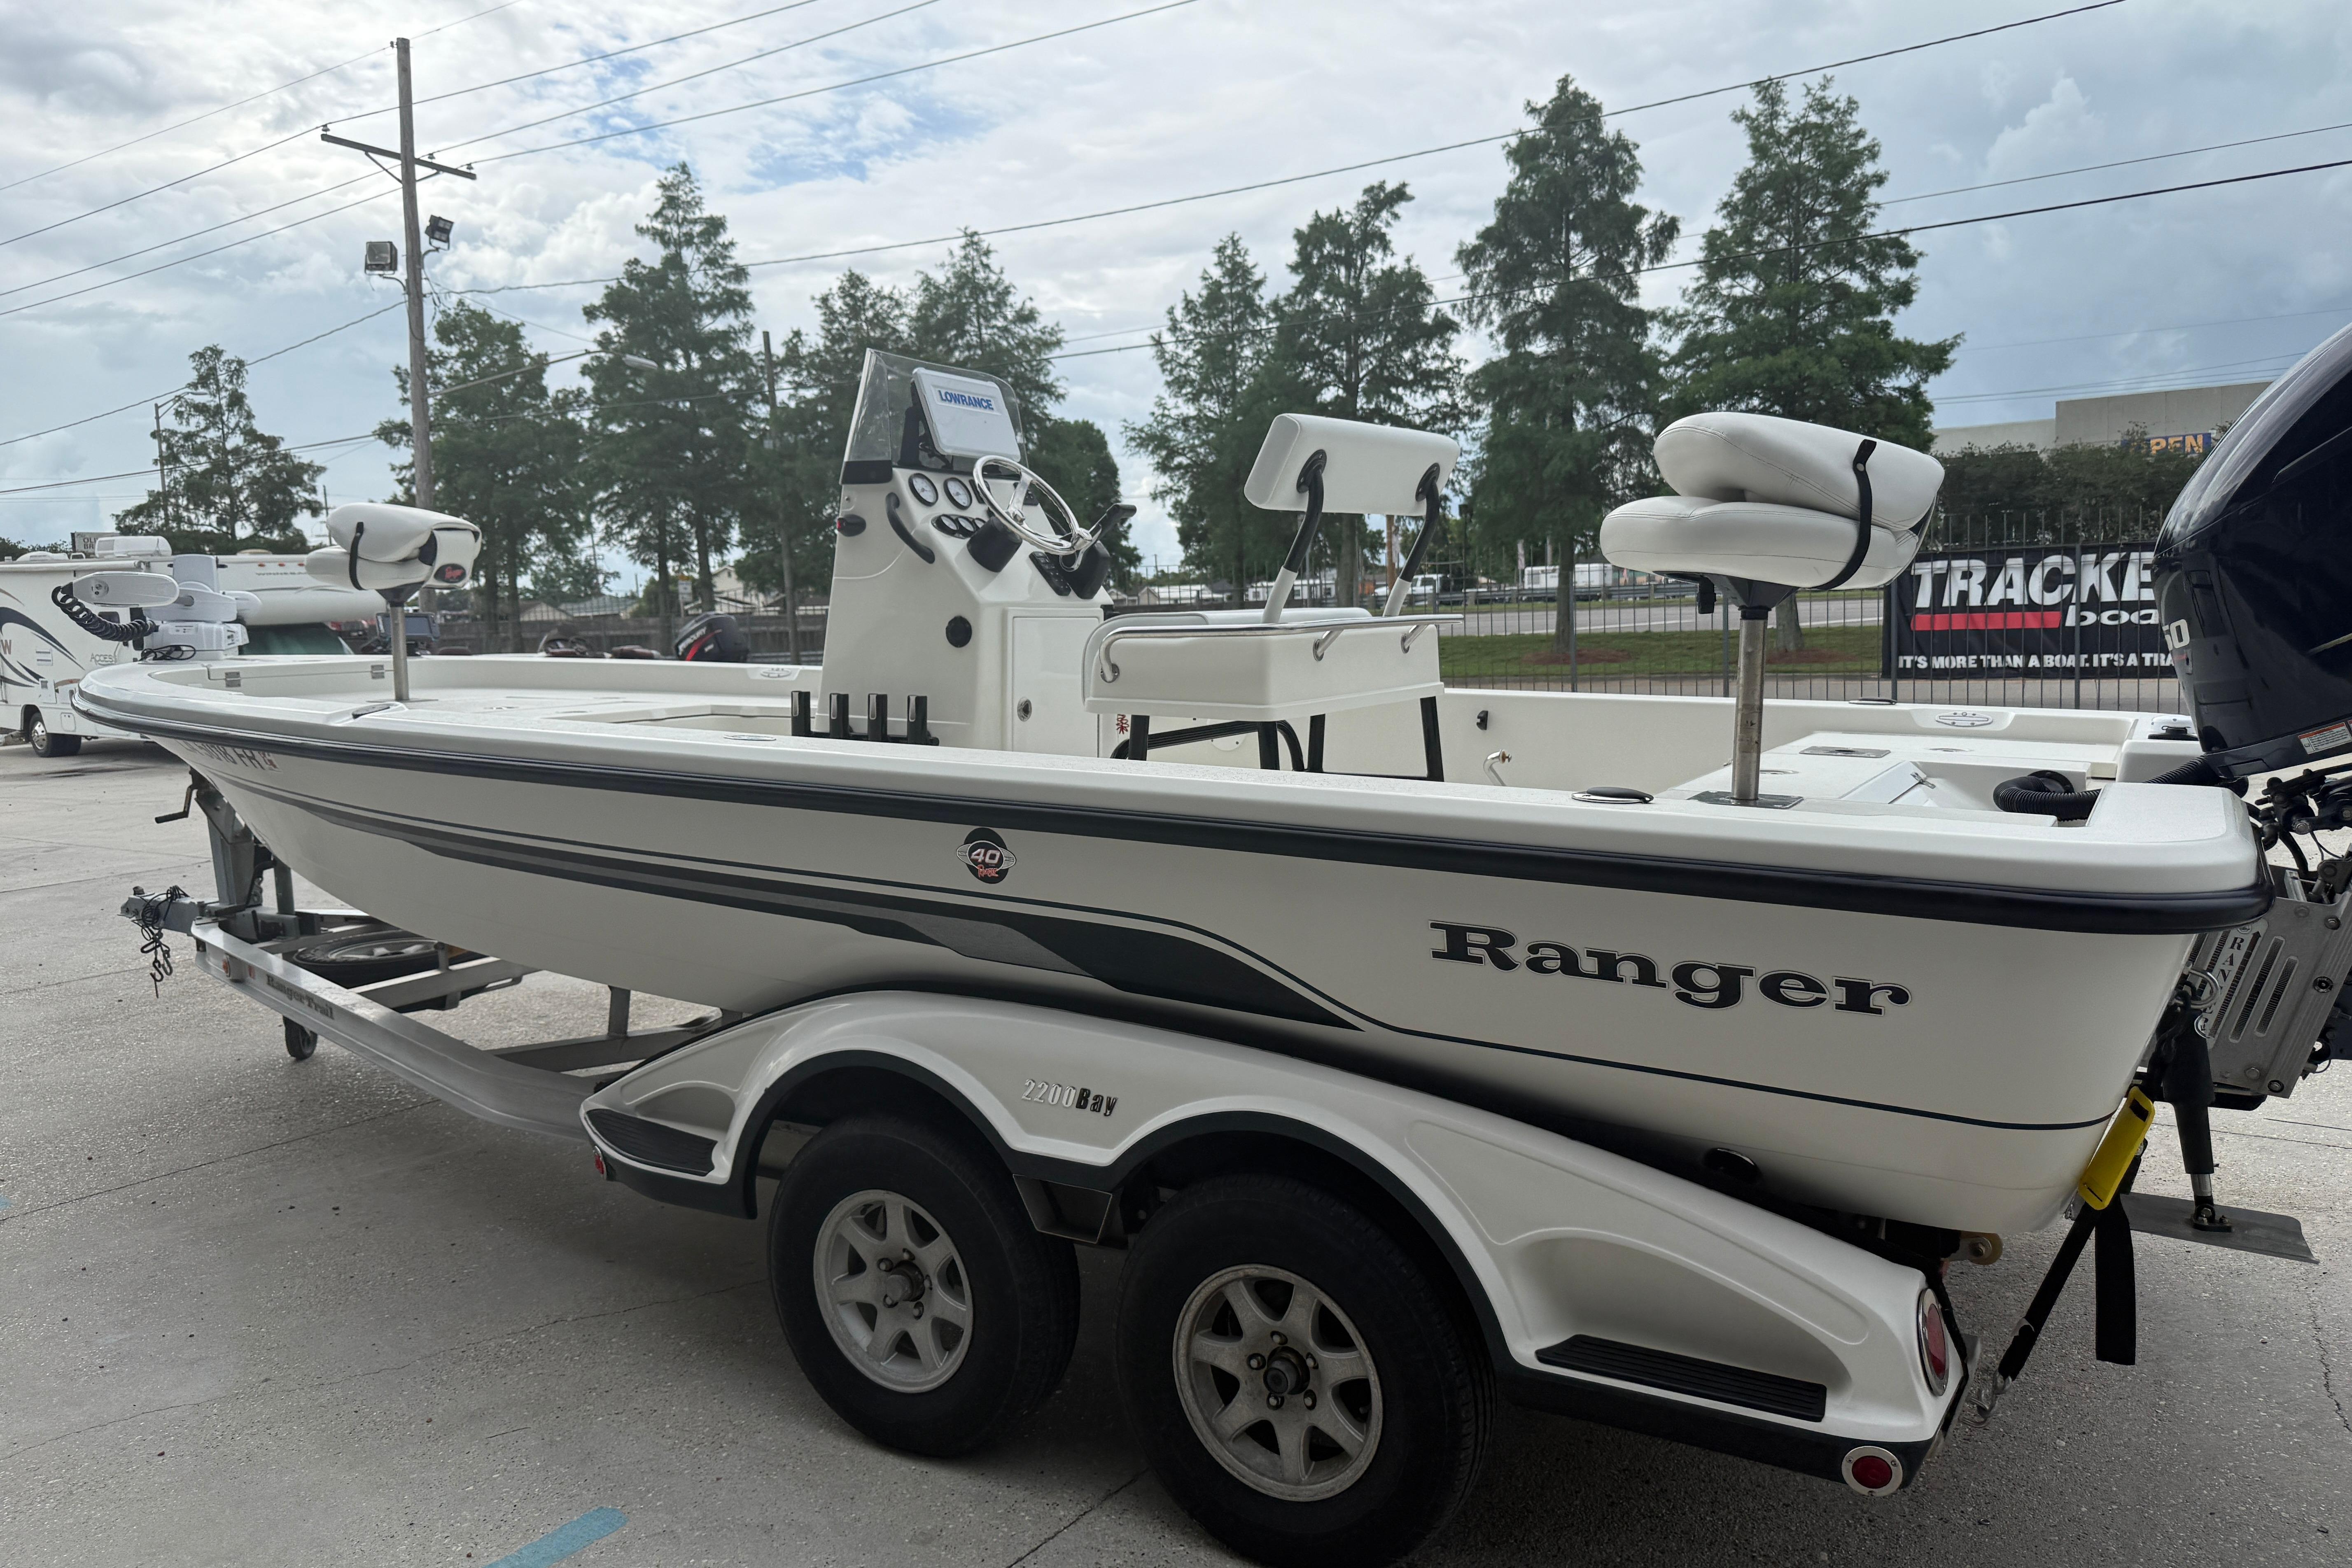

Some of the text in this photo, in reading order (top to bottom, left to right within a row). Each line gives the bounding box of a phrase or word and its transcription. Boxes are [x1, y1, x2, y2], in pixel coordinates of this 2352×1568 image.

[938, 390, 994, 410] LOWRANCE
[1898, 656, 1927, 668] IT'S
[1932, 656, 1977, 668] MORE
[1980, 655, 2023, 668] THAN
[2028, 655, 2040, 667] A
[2043, 654, 2089, 667] BOAT.
[2093, 653, 2123, 667] IT'S
[2126, 653, 2138, 667] A
[971, 848, 1000, 864] 40
[1428, 920, 1911, 1016] Ranger
